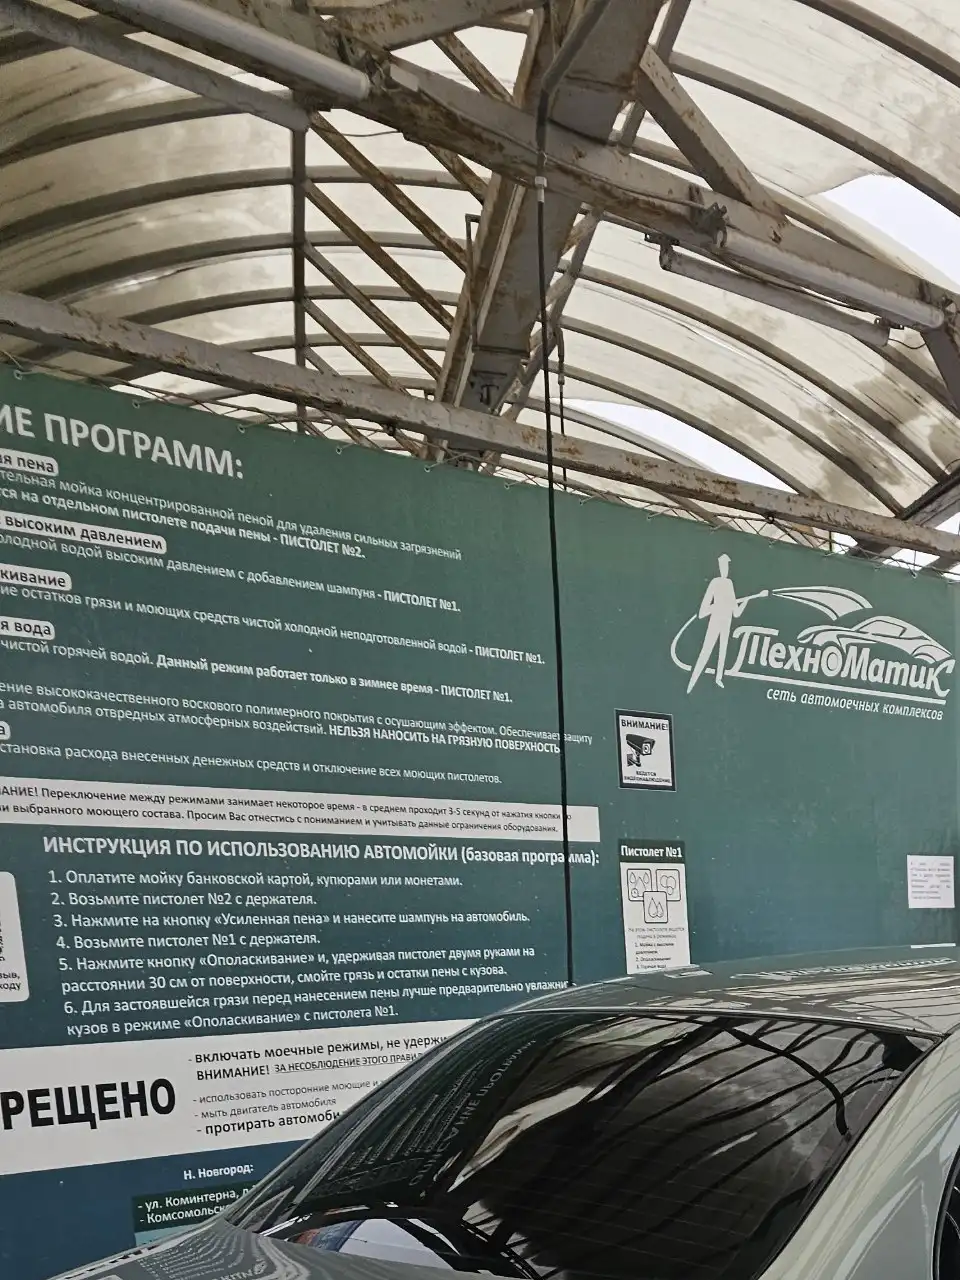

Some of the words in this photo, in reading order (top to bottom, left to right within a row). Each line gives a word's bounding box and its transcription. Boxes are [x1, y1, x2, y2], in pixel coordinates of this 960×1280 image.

[44, 412, 243, 479] ПРОГРАММ:
[16, 454, 54, 473] пена
[4, 515, 75, 536] высоким
[80, 528, 162, 549] давлением
[20, 491, 39, 504] на
[42, 495, 119, 516] отдельном
[121, 508, 187, 528] пистолете
[190, 520, 235, 536] подачи
[238, 527, 270, 541] пены
[280, 533, 339, 553] ПИСТОЛЕТ
[341, 544, 365, 558] №2.
[59, 480, 102, 495] мойка
[237, 512, 273, 526] пеной
[275, 519, 297, 530] для
[399, 541, 461, 560] загрязнений
[61, 542, 101, 558] водой
[105, 550, 163, 568] высоким
[166, 559, 235, 579] давлением
[246, 572, 324, 591] добавлением
[383, 589, 437, 608] ПИСТОЛЕТ
[14, 622, 51, 637] вода
[21, 588, 81, 604] остатков
[84, 597, 121, 610] грязи
[136, 603, 190, 619] моющих
[193, 611, 239, 625] средств
[242, 617, 281, 630] чистой
[284, 622, 337, 637] холодной
[474, 645, 523, 661] ПИСТОЛЕТ
[1, 640, 49, 653] чистой
[52, 645, 105, 659] горячей
[156, 655, 208, 671] Данный
[210, 662, 253, 674] режим
[255, 666, 307, 680] работает
[309, 672, 347, 685] только
[358, 677, 398, 690] зимнее
[400, 682, 432, 695] время
[440, 685, 490, 700] ПИСТОЛЕТ
[36, 685, 179, 707] высококачественного
[182, 699, 242, 713] воскового
[766, 688, 797, 703] сеть
[800, 691, 879, 713] автомоечных
[882, 703, 944, 721] комплексов
[8, 700, 91, 715] автомобиля
[328, 724, 370, 737] НЕЛЬЗЯ
[372, 728, 429, 742] НАНОСИТЬ
[447, 734, 492, 748] ГРЯЗНУЮ
[494, 738, 560, 753] ПОВЕРХНОСТЬ
[621, 719, 669, 731] ВНИМАНИЕ!
[64, 747, 118, 761] расхода
[121, 750, 190, 764] внесенных
[41, 788, 126, 801] Переключение
[129, 794, 165, 804] между
[12, 802, 83, 815] выбранного
[86, 807, 138, 818] моющего
[187, 809, 226, 821] Просим
[372, 818, 416, 828] учитывать
[42, 836, 171, 856] ИНСТРУКЦИЯ
[176, 840, 202, 856] ПО
[207, 841, 360, 859] ИСПОЛЬЗОВАНИЮ
[363, 842, 458, 861] АВТОМОЙКИ
[460, 846, 519, 863] (базовая
[620, 845, 664, 857] Пистолет
[665, 846, 683, 858] №1
[47, 870, 61, 883] 1.
[65, 870, 135, 883] Оплатите
[139, 871, 183, 885] мойку
[186, 871, 264, 885] банковской
[266, 872, 313, 886] картой,
[316, 874, 377, 886] купюрами
[379, 875, 401, 885] или
[404, 875, 463, 886] монетами.
[50, 892, 64, 905] 2.
[68, 892, 139, 905] Возьмите
[143, 894, 204, 905] пистолет
[207, 892, 231, 904] №2
[245, 894, 316, 906] держателя.
[53, 913, 67, 926] 3.
[71, 913, 138, 926] Нажмите
[162, 915, 210, 927] кнопку
[343, 913, 396, 923] нанесите
[398, 912, 448, 924] шампунь
[55, 936, 69, 949] 4.
[73, 936, 144, 948] Возьмите
[147, 936, 209, 948] пистолет
[211, 933, 236, 946] №1
[249, 934, 320, 947] держателя.
[58, 957, 72, 969] 5.
[76, 957, 143, 969] Нажмите
[147, 957, 195, 968] кнопку
[200, 951, 313, 966] «Ополаскивание»
[331, 950, 394, 964] удерживая
[397, 949, 446, 960] пистолет
[61, 979, 145, 992] расстоянии
[149, 976, 166, 989] 30
[297, 969, 340, 983] смойте
[343, 969, 374, 982] грязь
[386, 967, 429, 978] остатки
[431, 965, 459, 976] пены
[63, 1000, 77, 1012] 6.
[81, 999, 110, 1013] Для
[113, 995, 210, 1010] застоявшейся
[213, 996, 249, 1008] грязи
[252, 993, 291, 1006] перед
[294, 989, 367, 1002] нанесением
[370, 987, 399, 998] пены
[402, 985, 436, 998] лучше
[438, 981, 522, 996] предварительно
[67, 1023, 108, 1036] кузов
[124, 1019, 180, 1033] режиме
[183, 1009, 300, 1028] «Ополаскивание»
[313, 1007, 371, 1020] пистолета
[194, 1050, 260, 1063] включать
[264, 1045, 323, 1058] моечные
[327, 1041, 383, 1055] режимы,
[386, 1038, 400, 1049] не
[196, 1066, 269, 1080] ВНИМАНИЕ!
[288, 1058, 359, 1072] НЕСОБЛЮДЕНИЕ
[362, 1055, 388, 1065] ЭТОГО
[2, 1077, 177, 1131] РЕЩЕНО
[199, 1091, 266, 1103] использовать
[268, 1085, 329, 1098] посторонние
[200, 1108, 227, 1117] мыть
[229, 1103, 278, 1117] двигатель
[280, 1097, 336, 1111] автомобиля
[205, 1118, 275, 1135] протирать
[278, 1110, 340, 1127] автомоби
[183, 1170, 196, 1180] Н.
[198, 1163, 254, 1179] Новгород:
[145, 1200, 163, 1213] ул.
[165, 1188, 239, 1208] Коминтерна,
